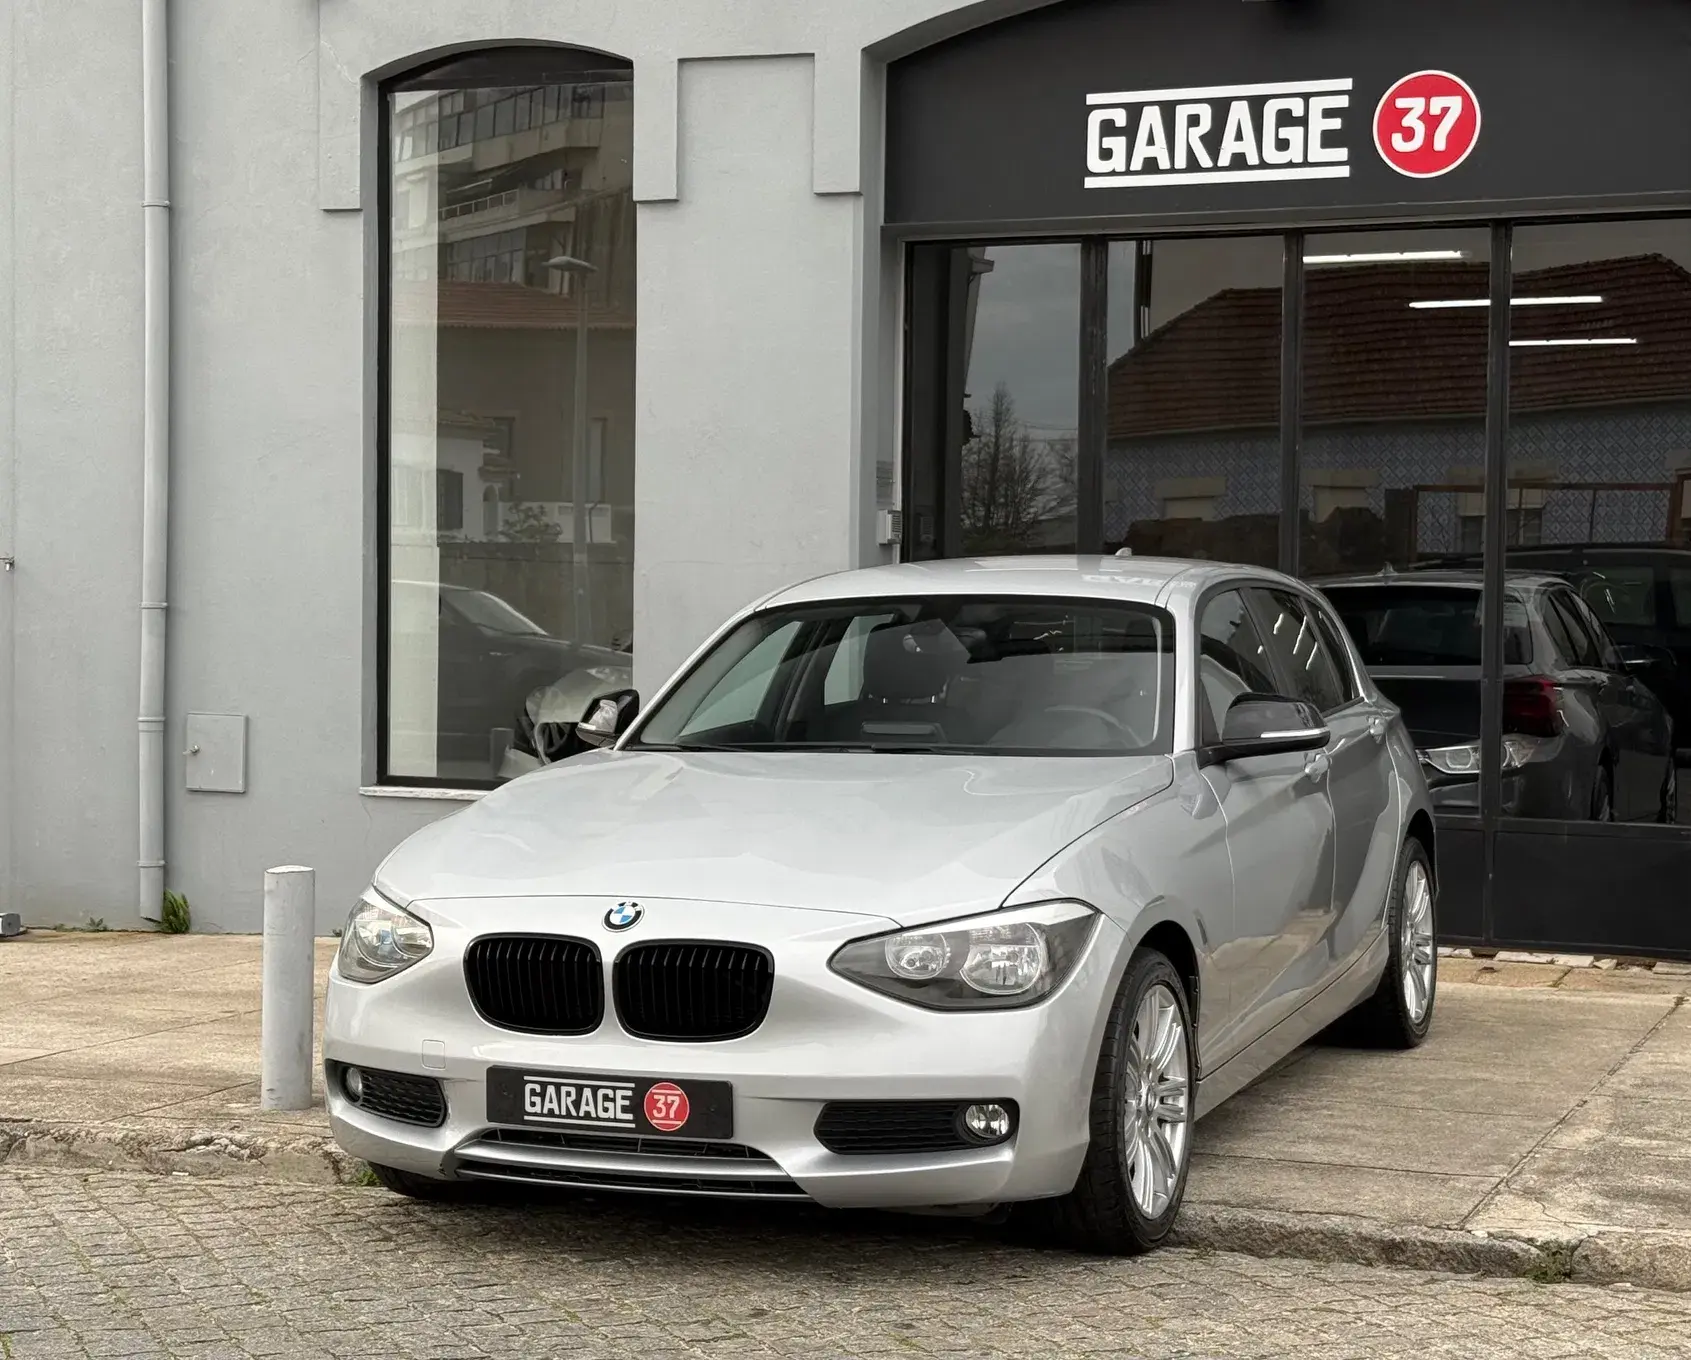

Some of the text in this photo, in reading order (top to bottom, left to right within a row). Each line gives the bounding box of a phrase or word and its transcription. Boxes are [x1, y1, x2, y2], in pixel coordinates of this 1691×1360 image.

[1086, 94, 1463, 174] GARAGE 37
[524, 1082, 681, 1121] GARAGE 37
